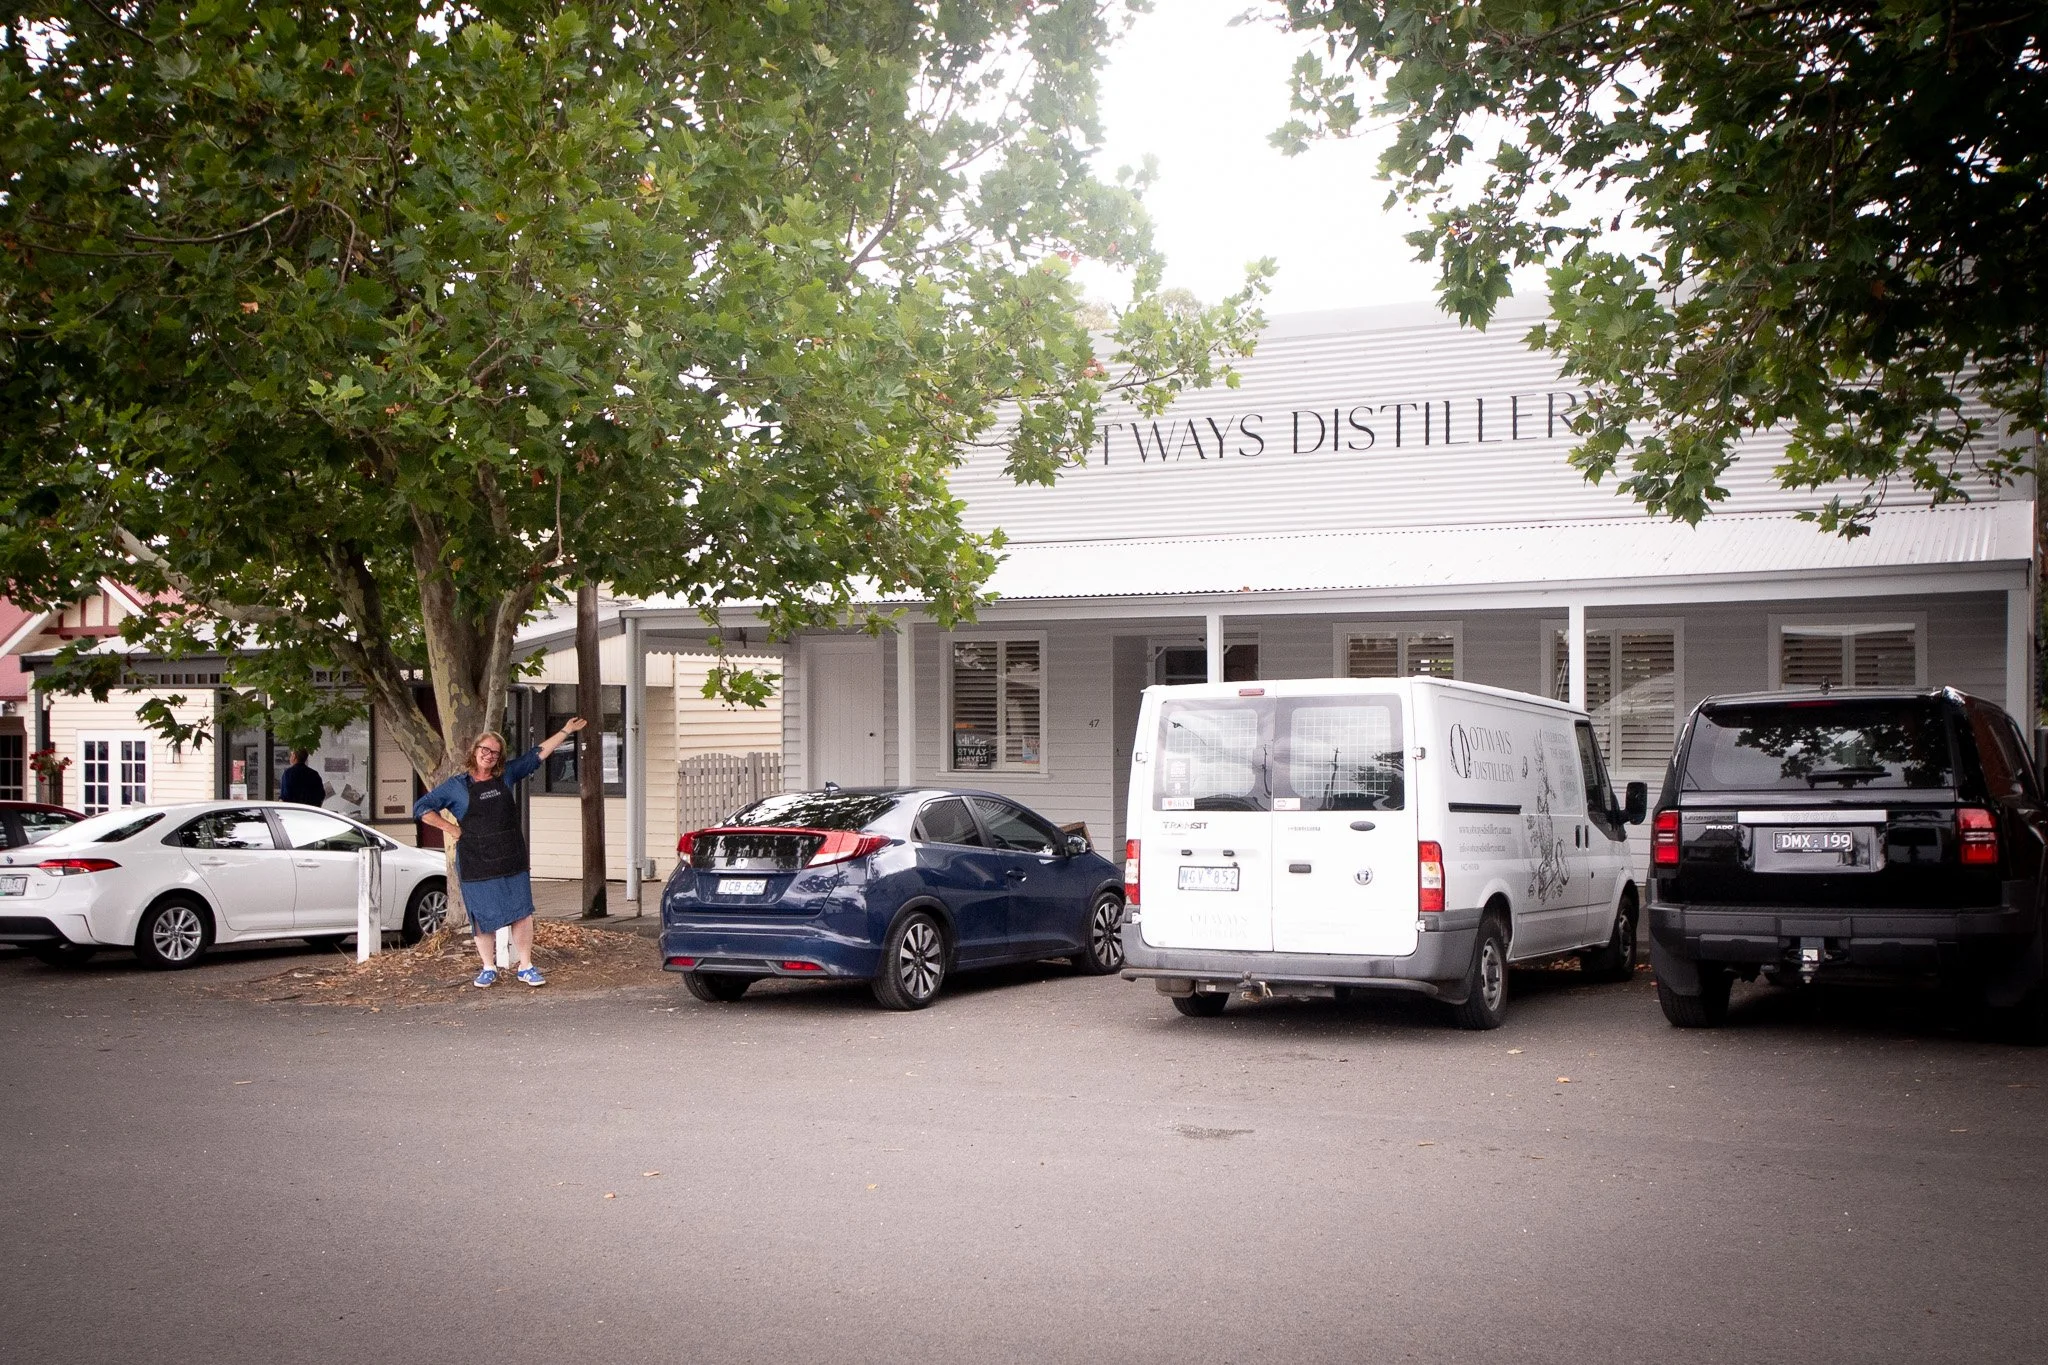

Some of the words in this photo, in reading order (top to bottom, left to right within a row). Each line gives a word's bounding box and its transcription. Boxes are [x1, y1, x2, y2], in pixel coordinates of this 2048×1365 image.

[1060, 413, 1266, 469] TWAYS
[1089, 719, 1100, 728] 47
[1469, 726, 1513, 755] OTWAYS
[957, 747, 987, 756] OTWAY
[1473, 760, 1515, 783] DISTILLERY
[1782, 812, 1838, 822] TOYOTA
[1162, 821, 1208, 830] TRANSIT
[1782, 834, 1811, 848] DMX
[1823, 834, 1850, 848] 199
[1180, 870, 1204, 884] WGV
[1213, 870, 1237, 885] 852
